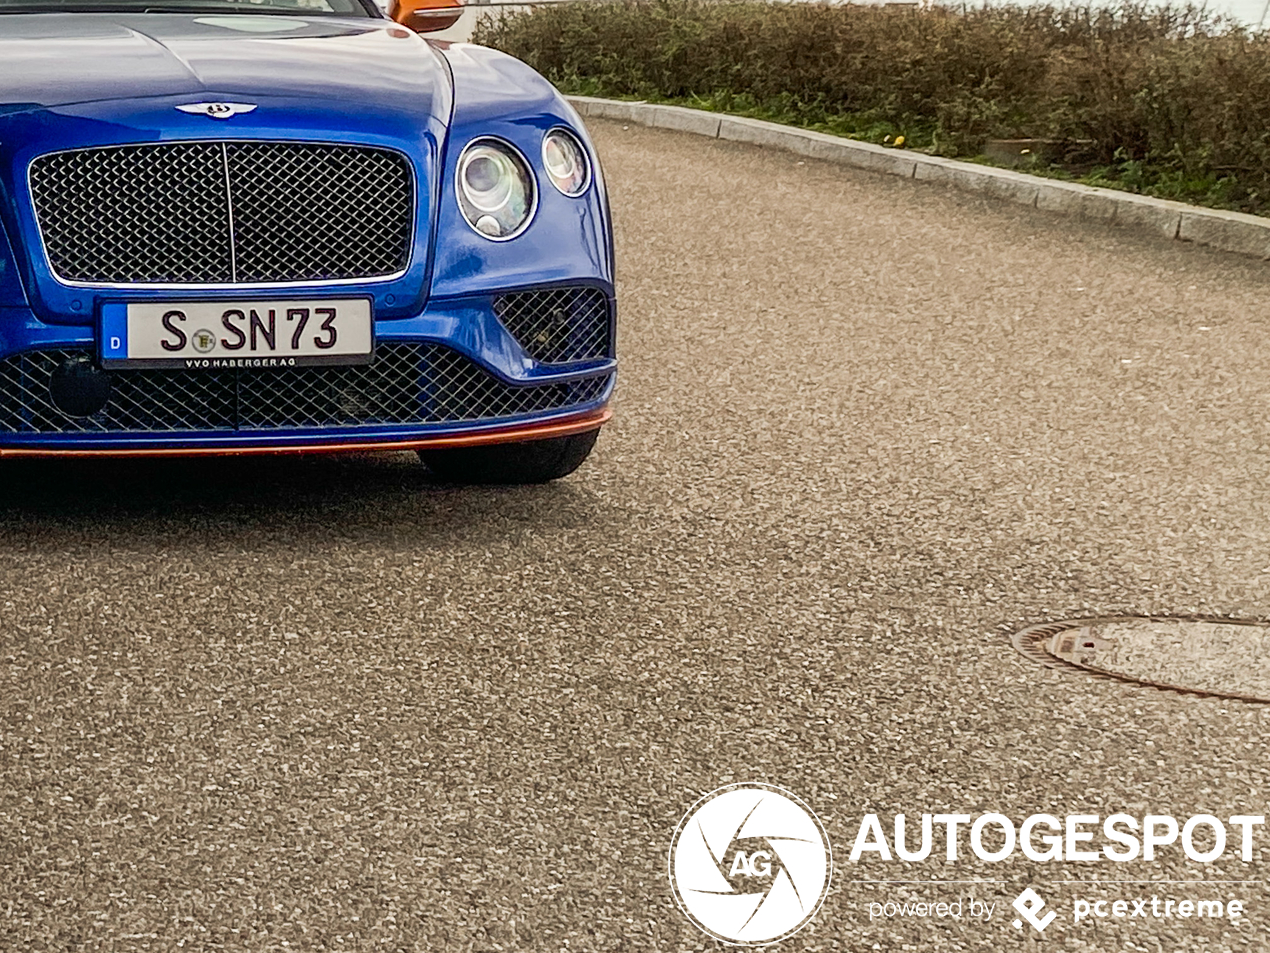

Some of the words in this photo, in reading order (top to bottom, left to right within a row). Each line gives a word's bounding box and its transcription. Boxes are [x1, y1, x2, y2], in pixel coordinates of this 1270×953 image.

[160, 310, 188, 352] S
[110, 336, 121, 350] D
[186, 359, 210, 368] VVO
[213, 359, 277, 367] HABERGER
[280, 358, 296, 366] AG
